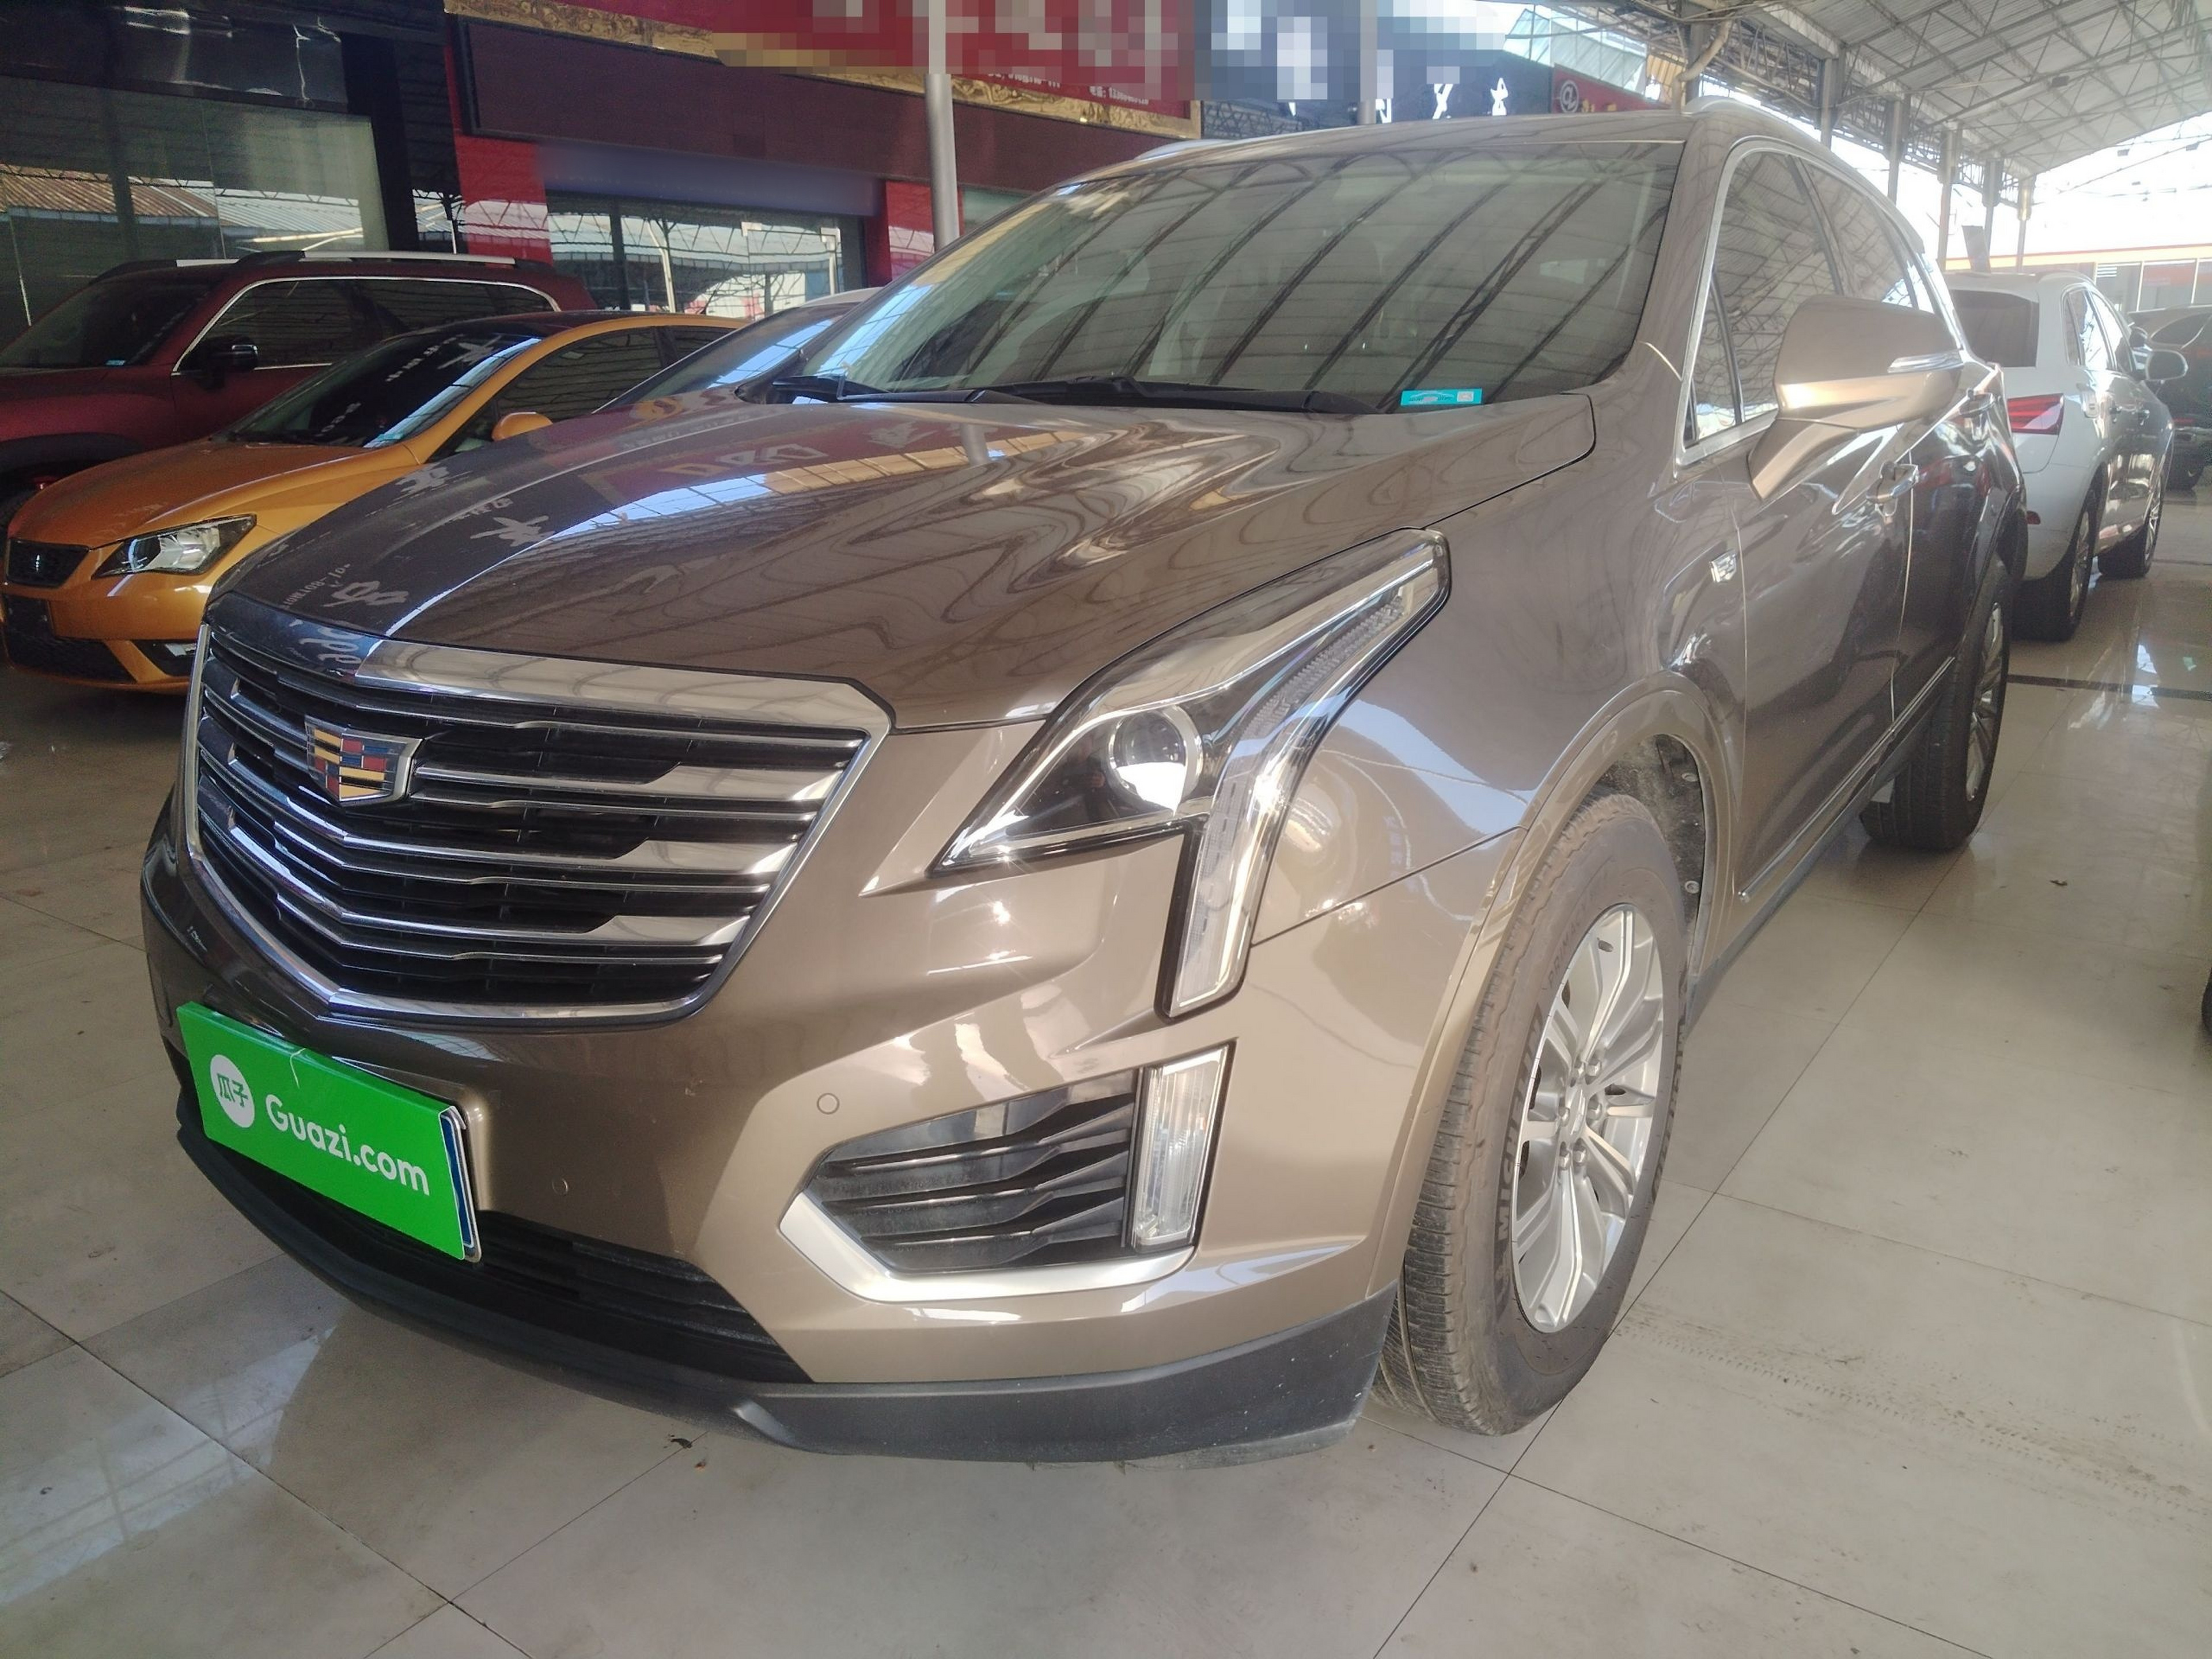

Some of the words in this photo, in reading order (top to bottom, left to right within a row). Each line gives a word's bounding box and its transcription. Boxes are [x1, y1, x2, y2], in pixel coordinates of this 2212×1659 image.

[215, 1072, 249, 1109] 瓜子
[1498, 1016, 1543, 1242] MICHELIN
[265, 1094, 430, 1196] Guazi.com
